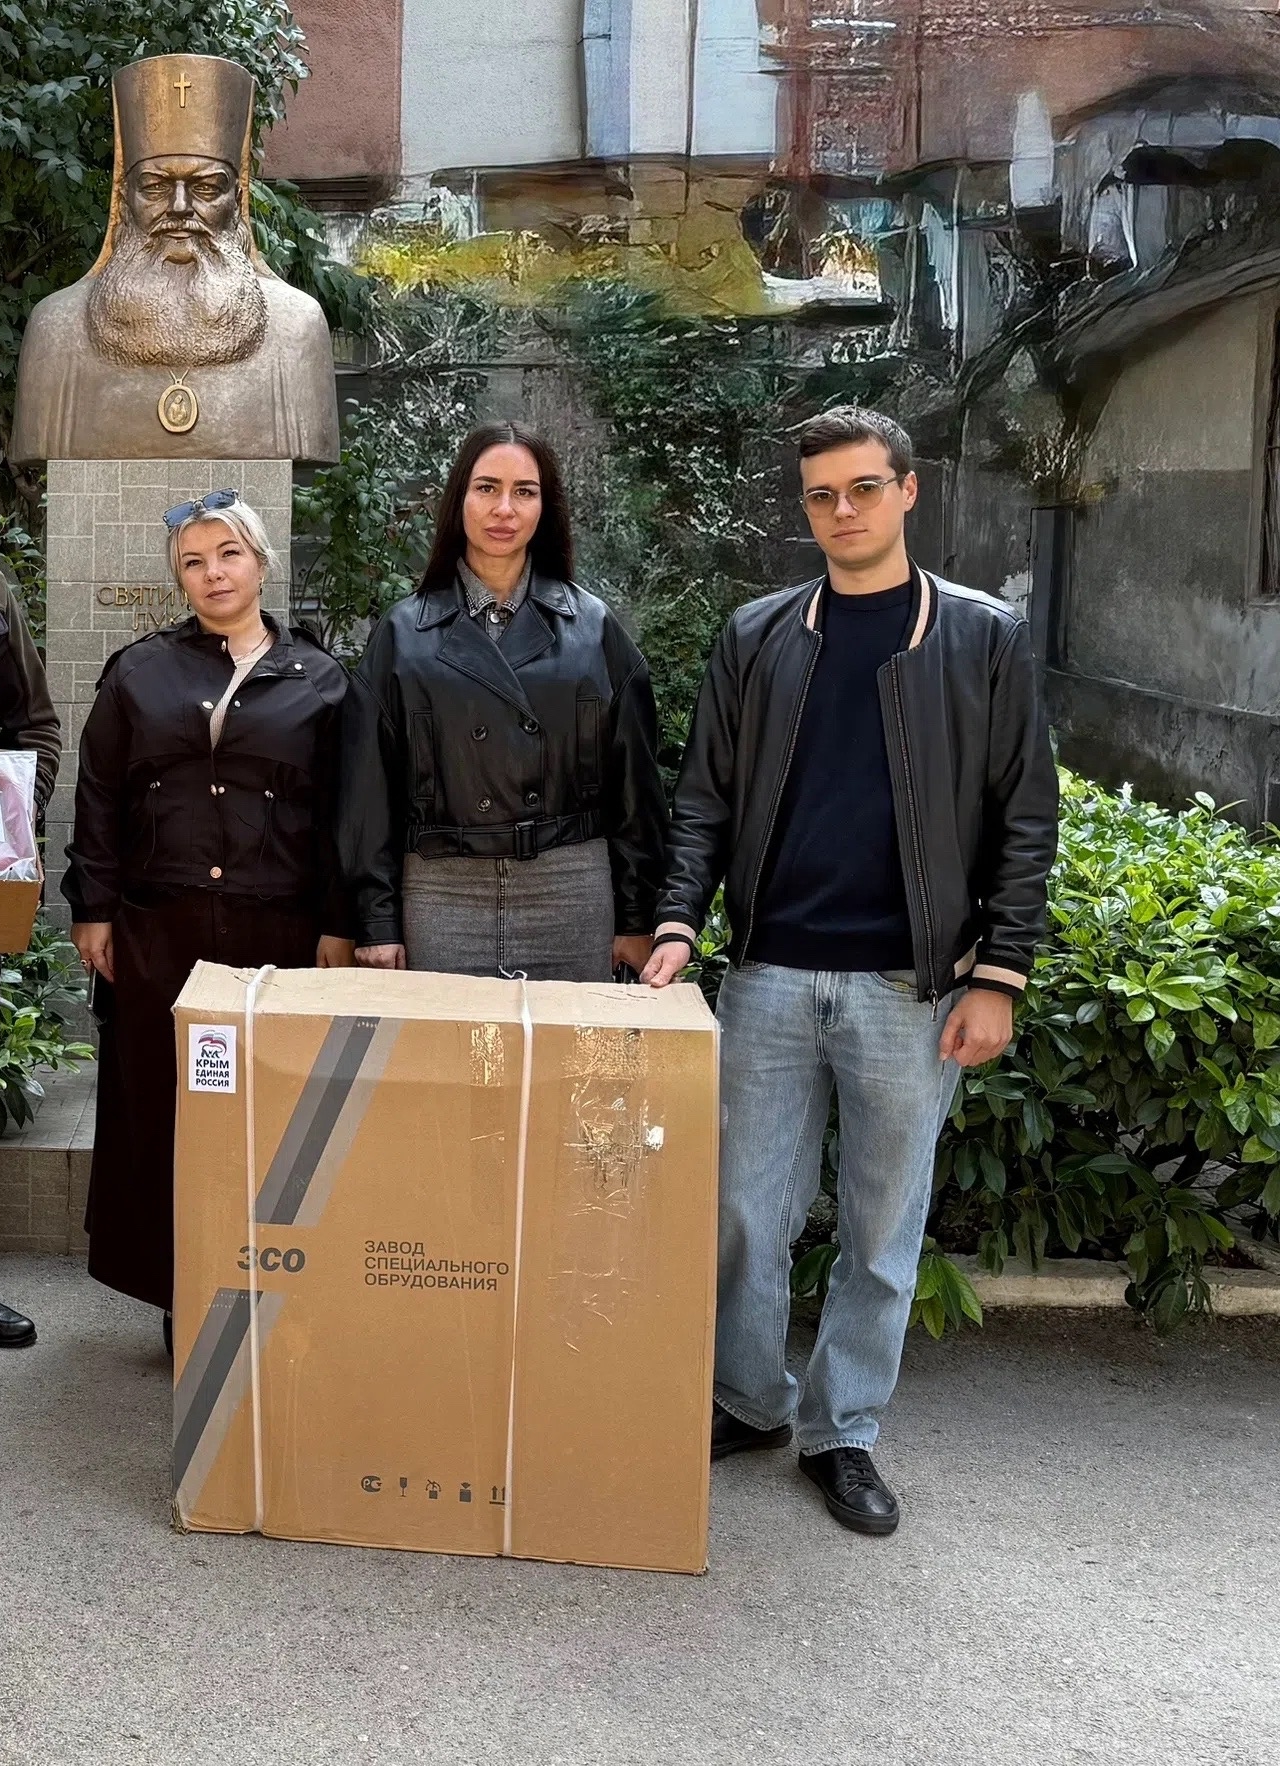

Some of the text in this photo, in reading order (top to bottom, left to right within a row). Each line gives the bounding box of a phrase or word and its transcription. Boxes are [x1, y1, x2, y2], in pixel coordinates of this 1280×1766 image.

[195, 1058, 230, 1069] КРЫМ
[195, 1068, 230, 1079] ЕДИНАЯ
[195, 1078, 230, 1088] РОССИЯ
[364, 1240, 426, 1257] ЗАВОД
[364, 1256, 510, 1276] СПЕЦИАЛЬНОГО
[364, 1272, 498, 1292] ОБРУДОВАНИЯ
